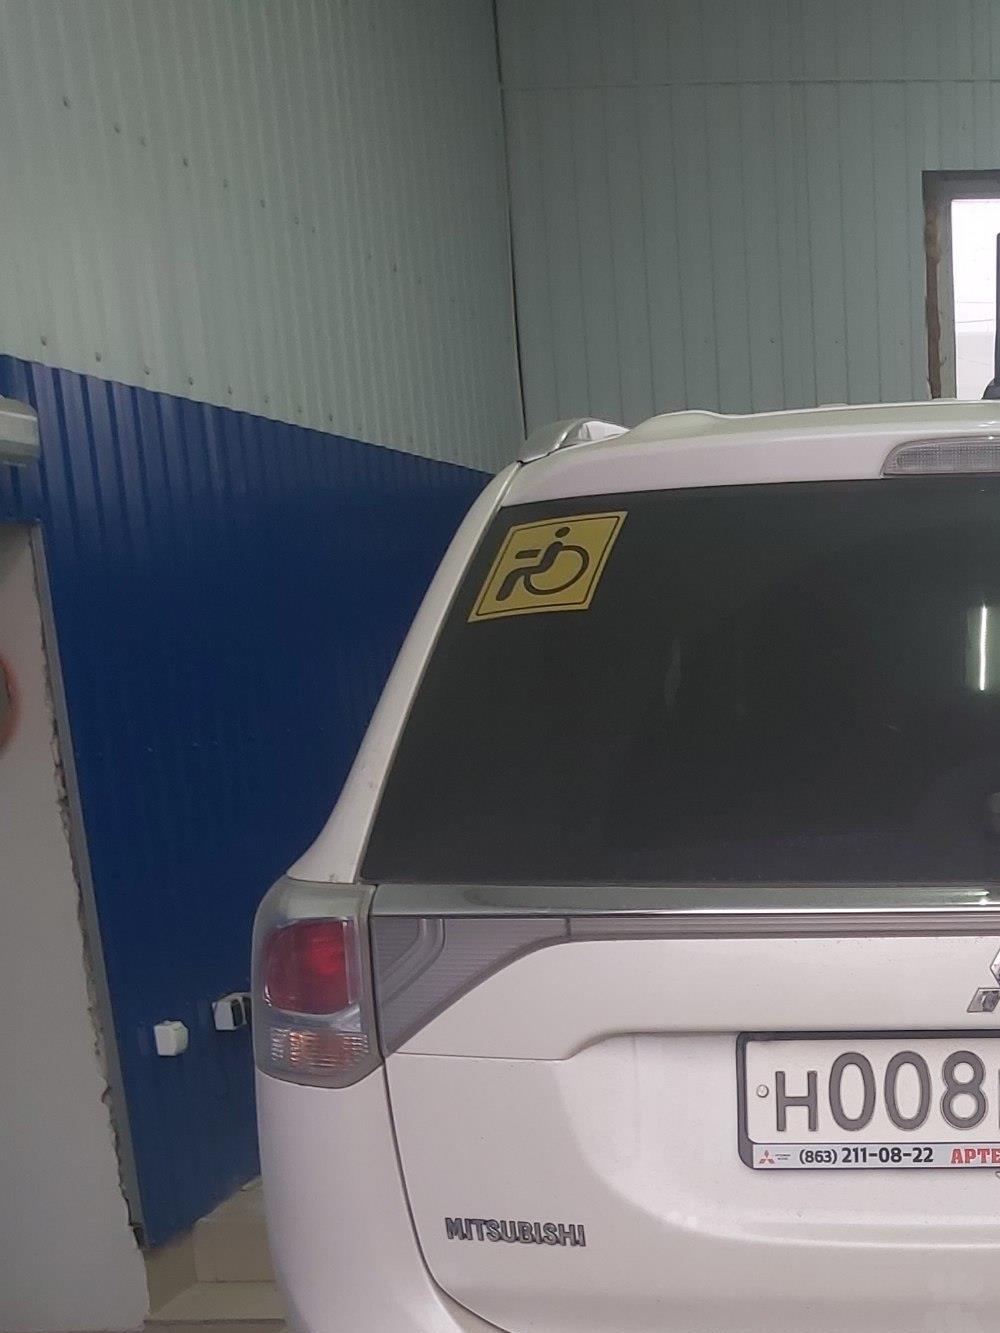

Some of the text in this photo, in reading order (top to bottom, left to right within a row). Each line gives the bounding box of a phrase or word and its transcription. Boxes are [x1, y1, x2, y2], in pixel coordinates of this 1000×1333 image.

[799, 1148, 837, 1164] (863)
[841, 1147, 934, 1163] 211-08-22
[445, 1217, 586, 1247] MITSUBISHI
